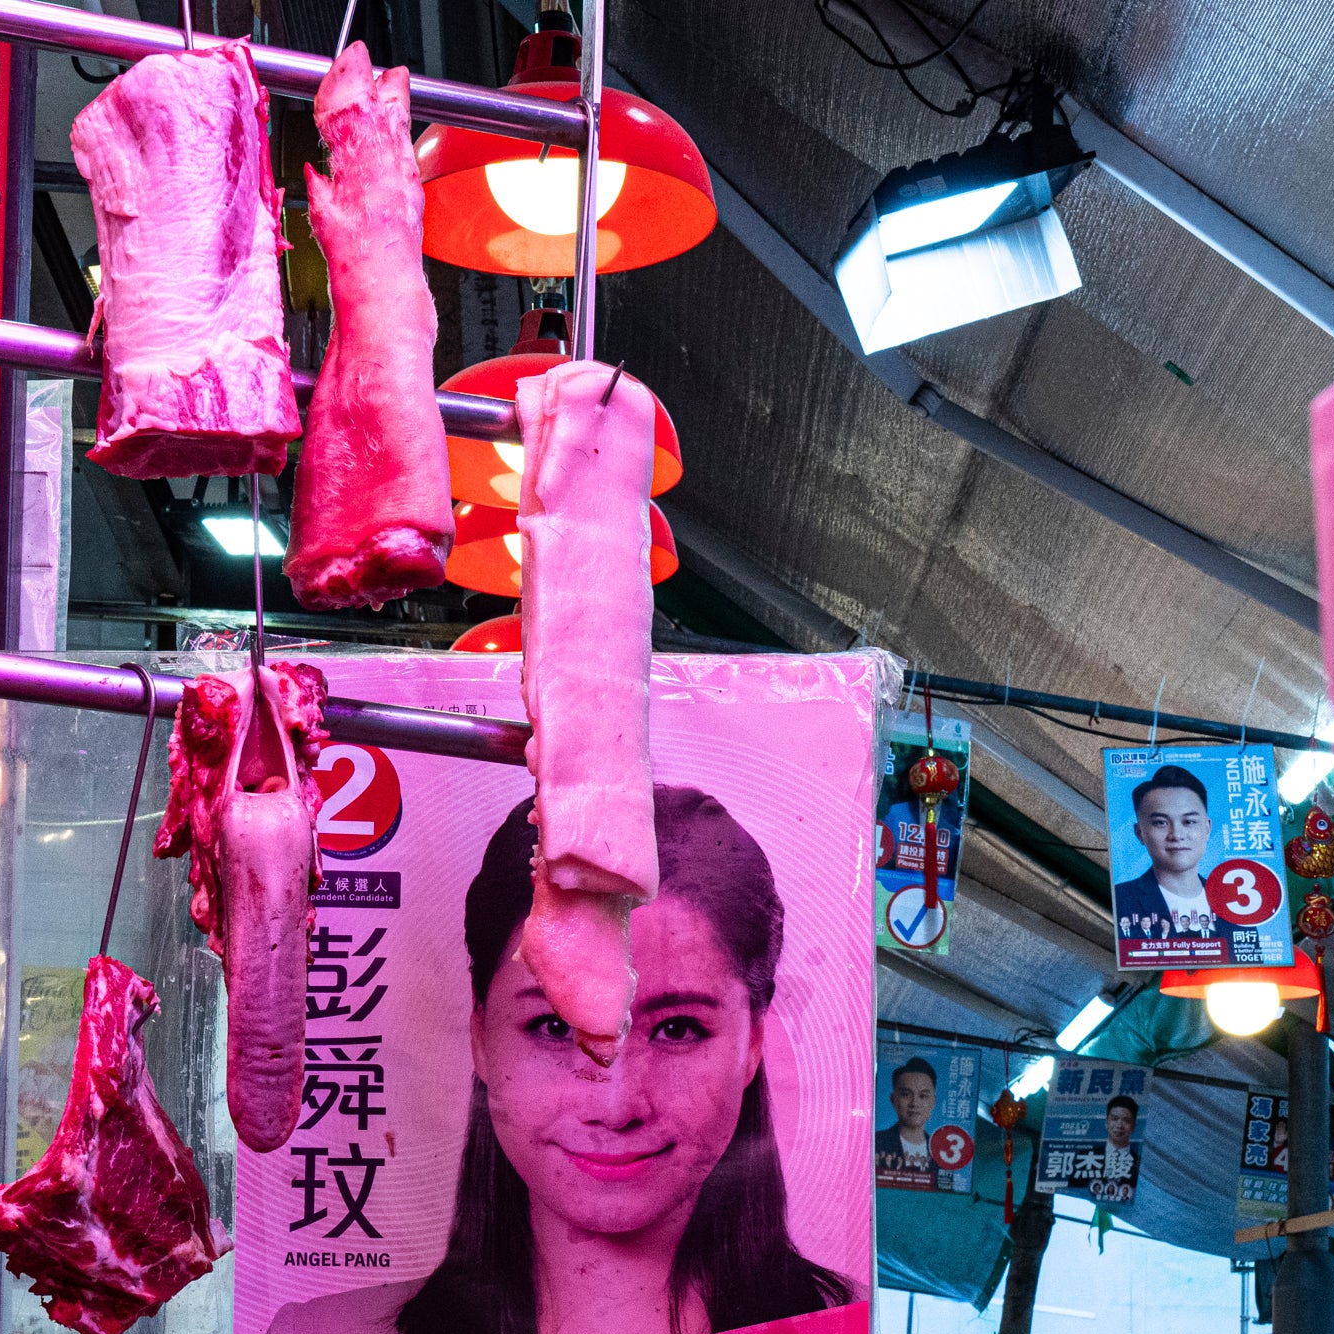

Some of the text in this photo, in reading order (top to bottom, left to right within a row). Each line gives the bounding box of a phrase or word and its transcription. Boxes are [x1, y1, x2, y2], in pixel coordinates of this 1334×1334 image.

[312, 744, 376, 836] 2
[1241, 754, 1273, 850] 施永泰
[1226, 757, 1246, 851] NOEL SHIH
[898, 821, 951, 848] 12.0
[308, 893, 394, 902] pendent Candidate
[318, 877, 388, 892] 立候選人
[1222, 868, 1262, 916] 3
[1172, 941, 1191, 949] Fully
[1191, 941, 1222, 949] Support
[1232, 930, 1258, 943] 同行
[1235, 953, 1283, 962] TOGETHER
[290, 926, 390, 1239] 彭舜玟
[1056, 1068, 1147, 1095] 新民黨
[939, 1133, 966, 1164] 3
[1273, 1147, 1288, 1172] 4
[1045, 1150, 1135, 1180] 郭杰駿
[284, 1251, 391, 1269] ANGEL PANG
